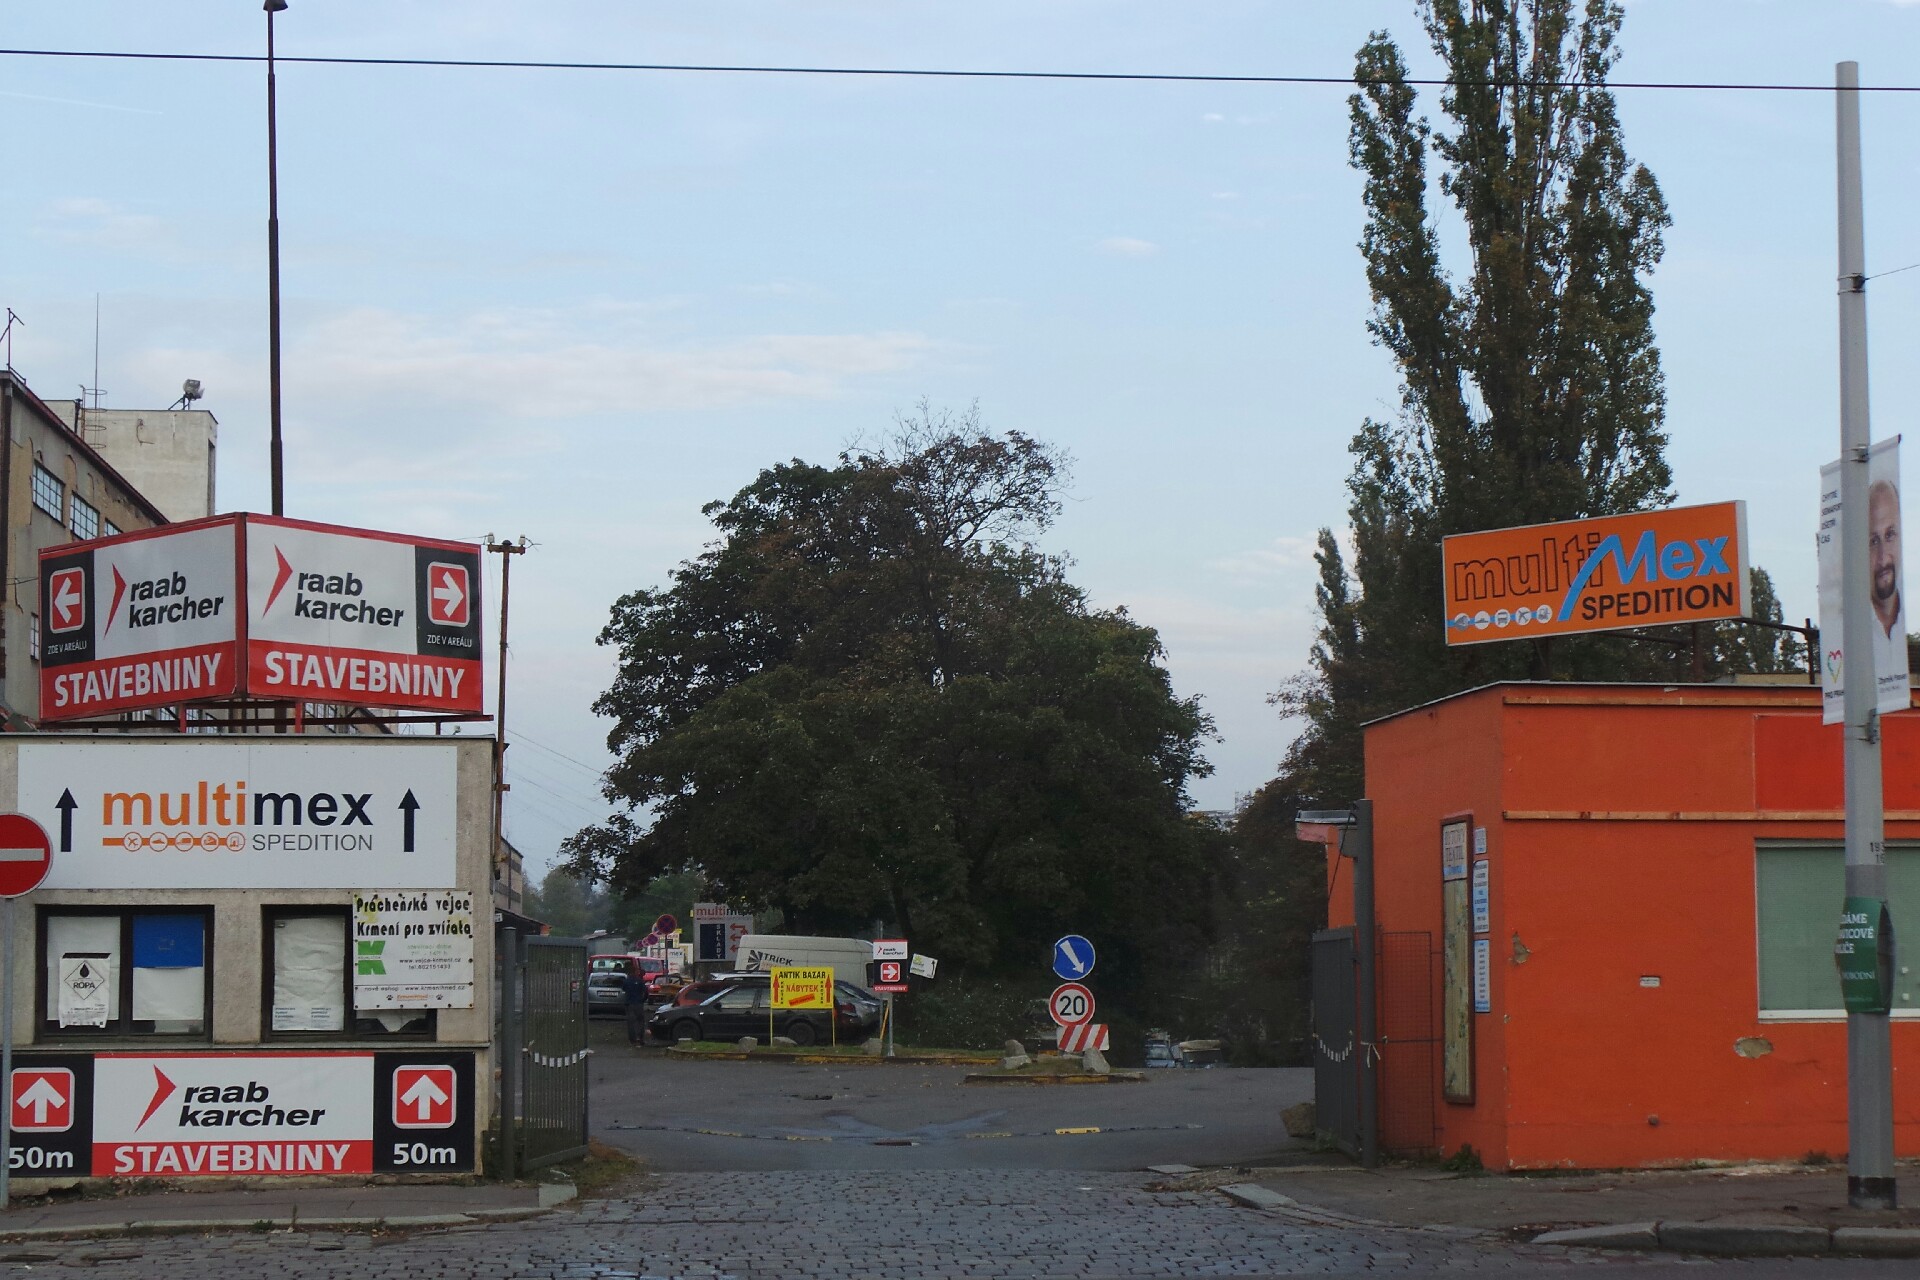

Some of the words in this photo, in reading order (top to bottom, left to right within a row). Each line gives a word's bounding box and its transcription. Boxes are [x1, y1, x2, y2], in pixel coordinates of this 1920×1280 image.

[130, 571, 187, 602] raab
[297, 572, 363, 597] raab
[128, 596, 224, 629] karcher
[294, 592, 404, 627] karcher
[1582, 582, 1734, 621] SPEDITION
[426, 634, 440, 645] ZDE
[448, 635, 473, 648] AREÁLU
[54, 652, 222, 708] STAVEBNINY
[265, 651, 465, 699] STAVEBNINY
[103, 781, 374, 826] multimex
[252, 834, 373, 851] SPEDITION
[436, 896, 470, 915] vejce
[357, 922, 400, 937] Krmení
[404, 924, 424, 939] pro
[428, 919, 471, 936] zvířata
[715, 924, 723, 960] SKLADY
[73, 981, 96, 990] ROPA
[778, 971, 801, 979] ANTIK
[802, 971, 826, 979] BAZAR
[786, 983, 819, 992] NÁBYTEK
[1059, 996, 1086, 1017] 20
[184, 1081, 269, 1104] raab
[179, 1105, 326, 1127] karcher
[9, 1146, 74, 1169] 50m
[114, 1144, 351, 1173] STAVEBNINY
[393, 1142, 457, 1165] 50m
